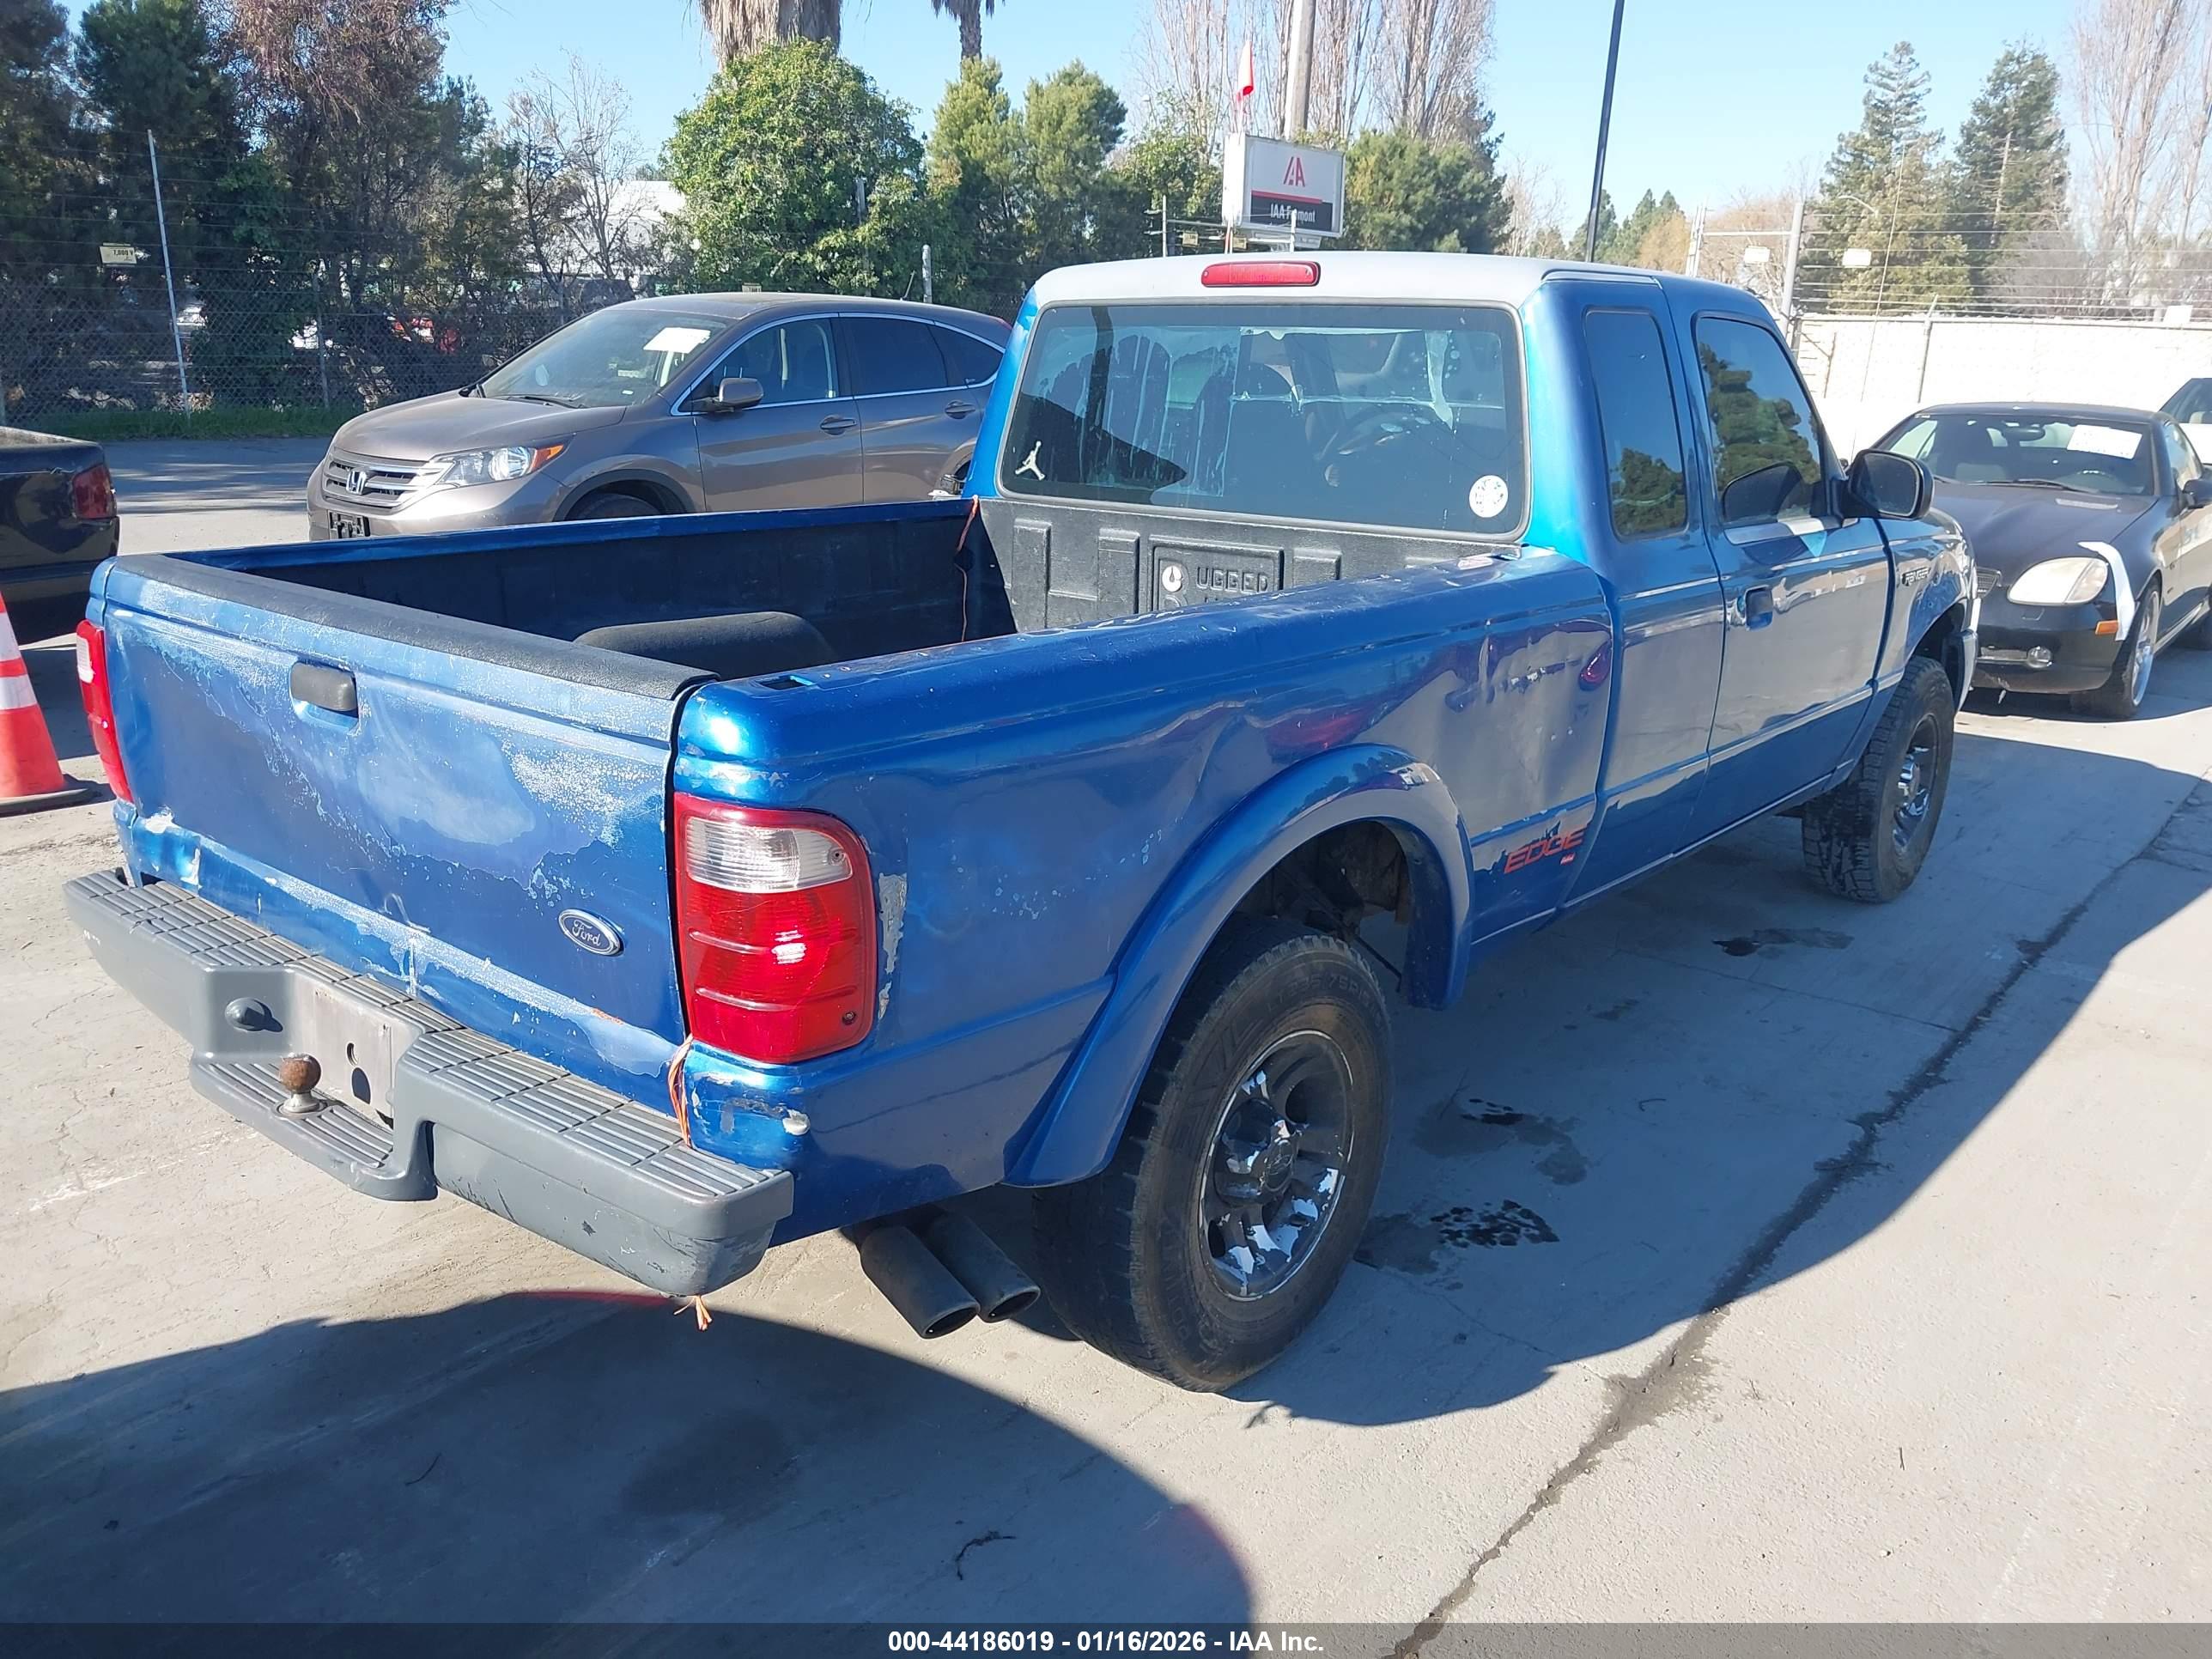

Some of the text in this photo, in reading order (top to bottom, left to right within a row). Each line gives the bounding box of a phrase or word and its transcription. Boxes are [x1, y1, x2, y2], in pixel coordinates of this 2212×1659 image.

[1270, 203, 1316, 222] IAA Fmont
[1504, 830, 1585, 874] EDGE
[572, 919, 602, 946] Ford
